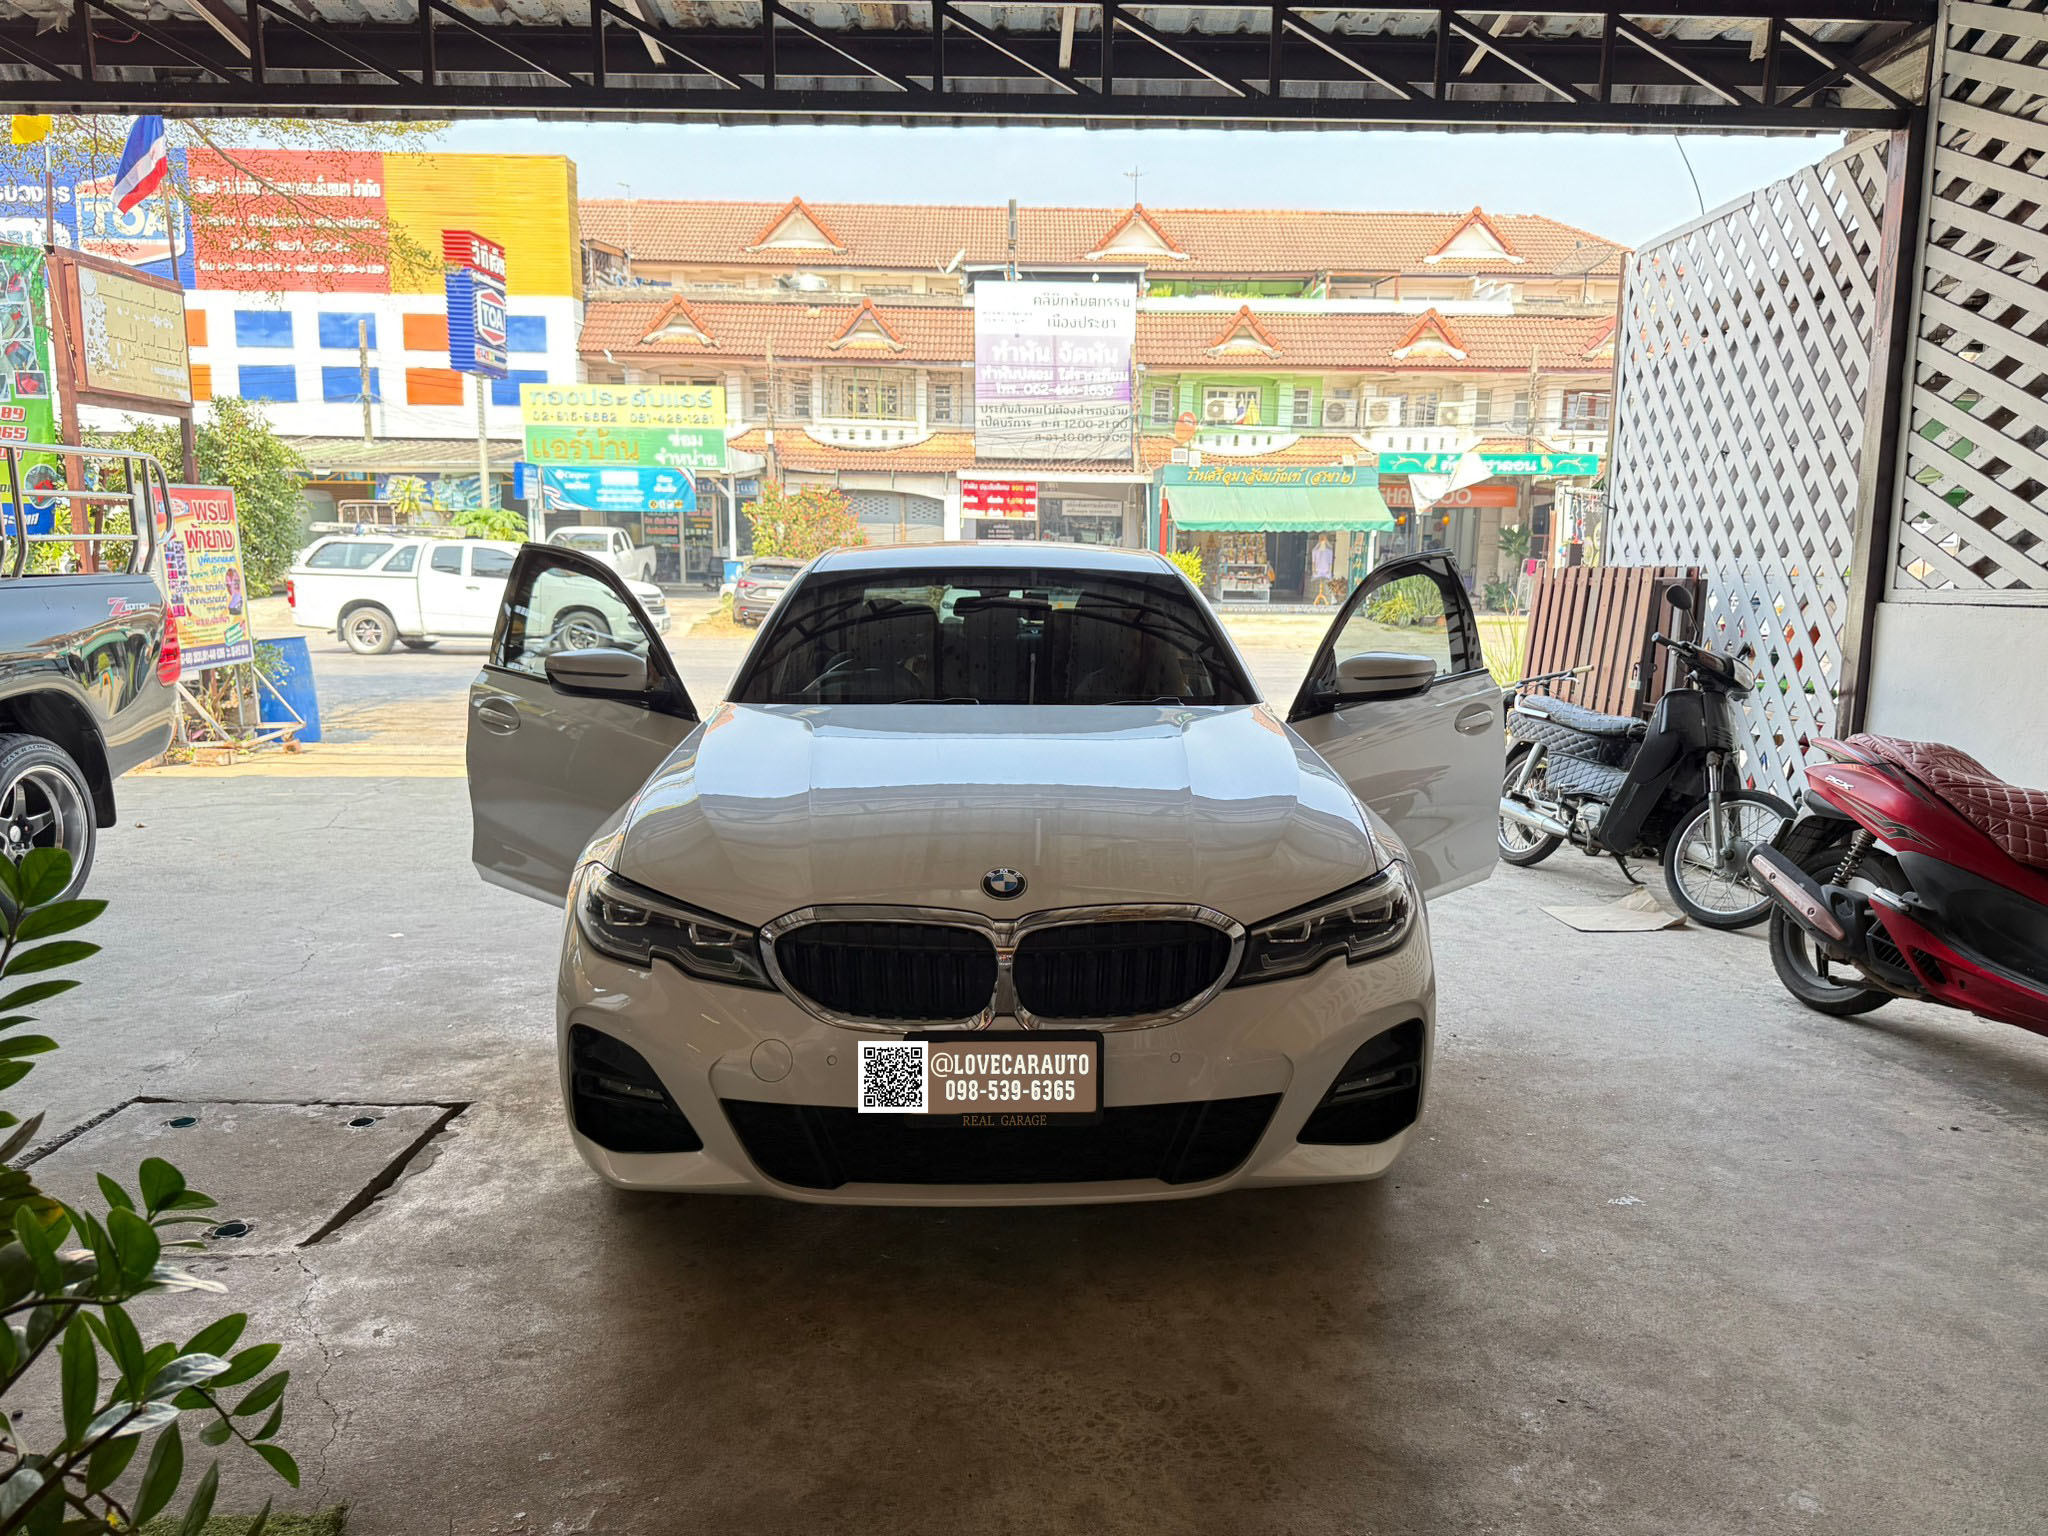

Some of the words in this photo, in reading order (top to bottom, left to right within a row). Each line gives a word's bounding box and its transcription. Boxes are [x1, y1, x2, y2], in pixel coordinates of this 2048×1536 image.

[481, 303, 504, 332] TOA
[532, 428, 640, 461] แอร์บ้าน
[192, 501, 230, 524] พรม
[184, 523, 235, 553] ผ้ายาง
[963, 1115, 995, 1127] REAL
[1001, 1114, 1047, 1127] GARAGE
